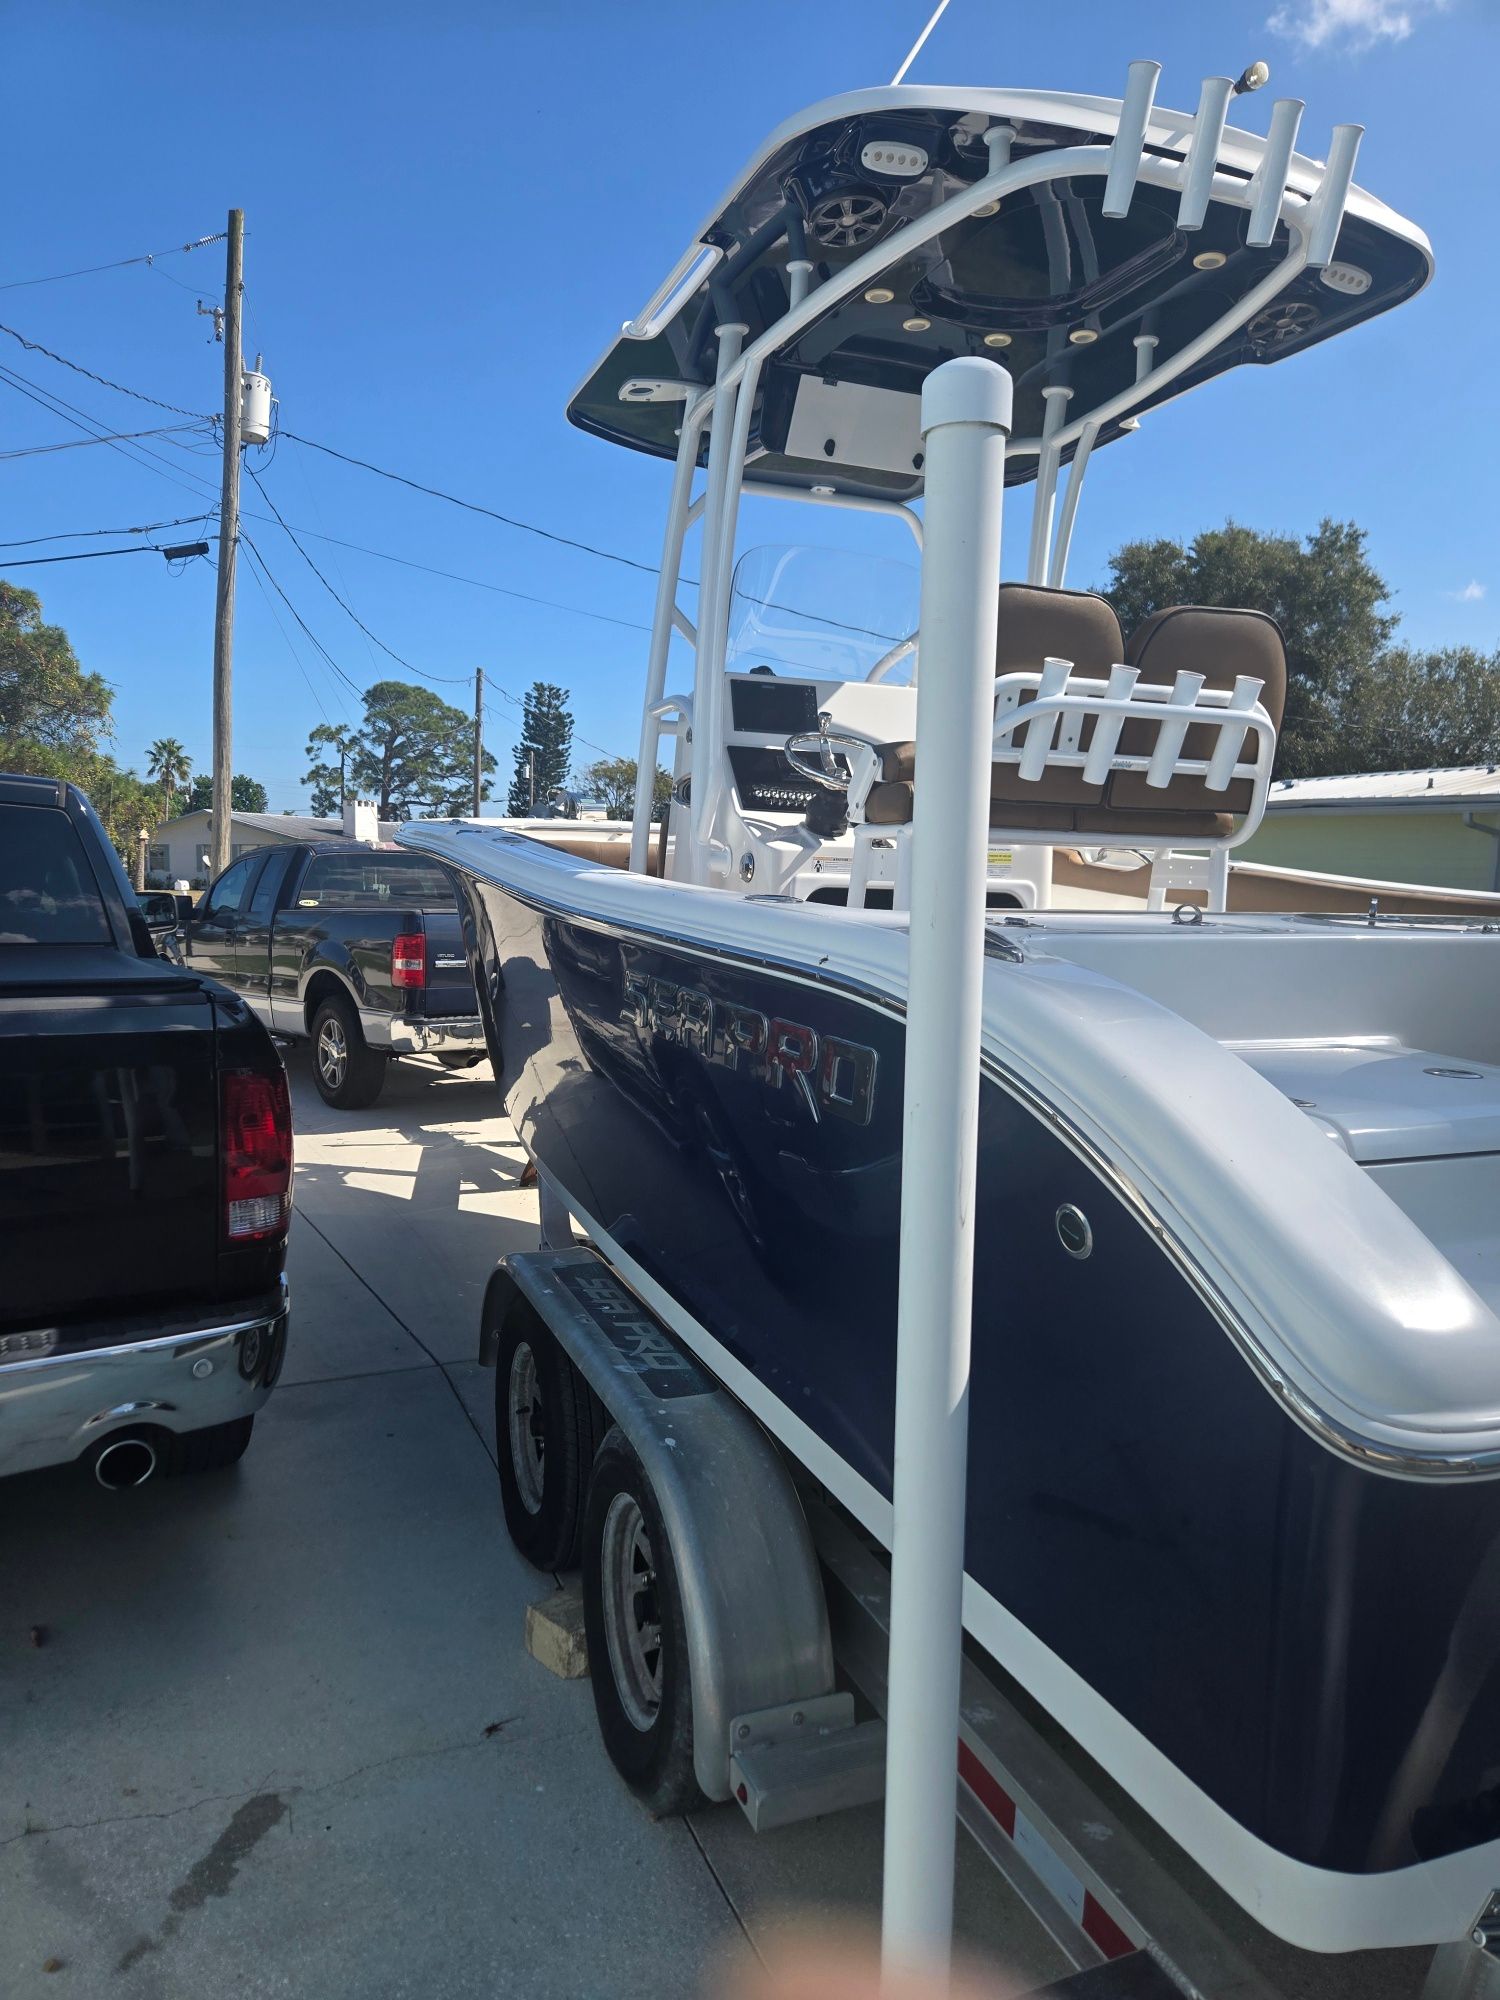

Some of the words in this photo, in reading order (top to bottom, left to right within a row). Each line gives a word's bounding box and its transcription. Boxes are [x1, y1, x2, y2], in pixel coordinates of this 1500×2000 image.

[620, 969, 713, 1058] SEA
[713, 998, 879, 1126] PRO
[575, 1277, 640, 1314] SEA
[612, 1321, 692, 1370] PRO
